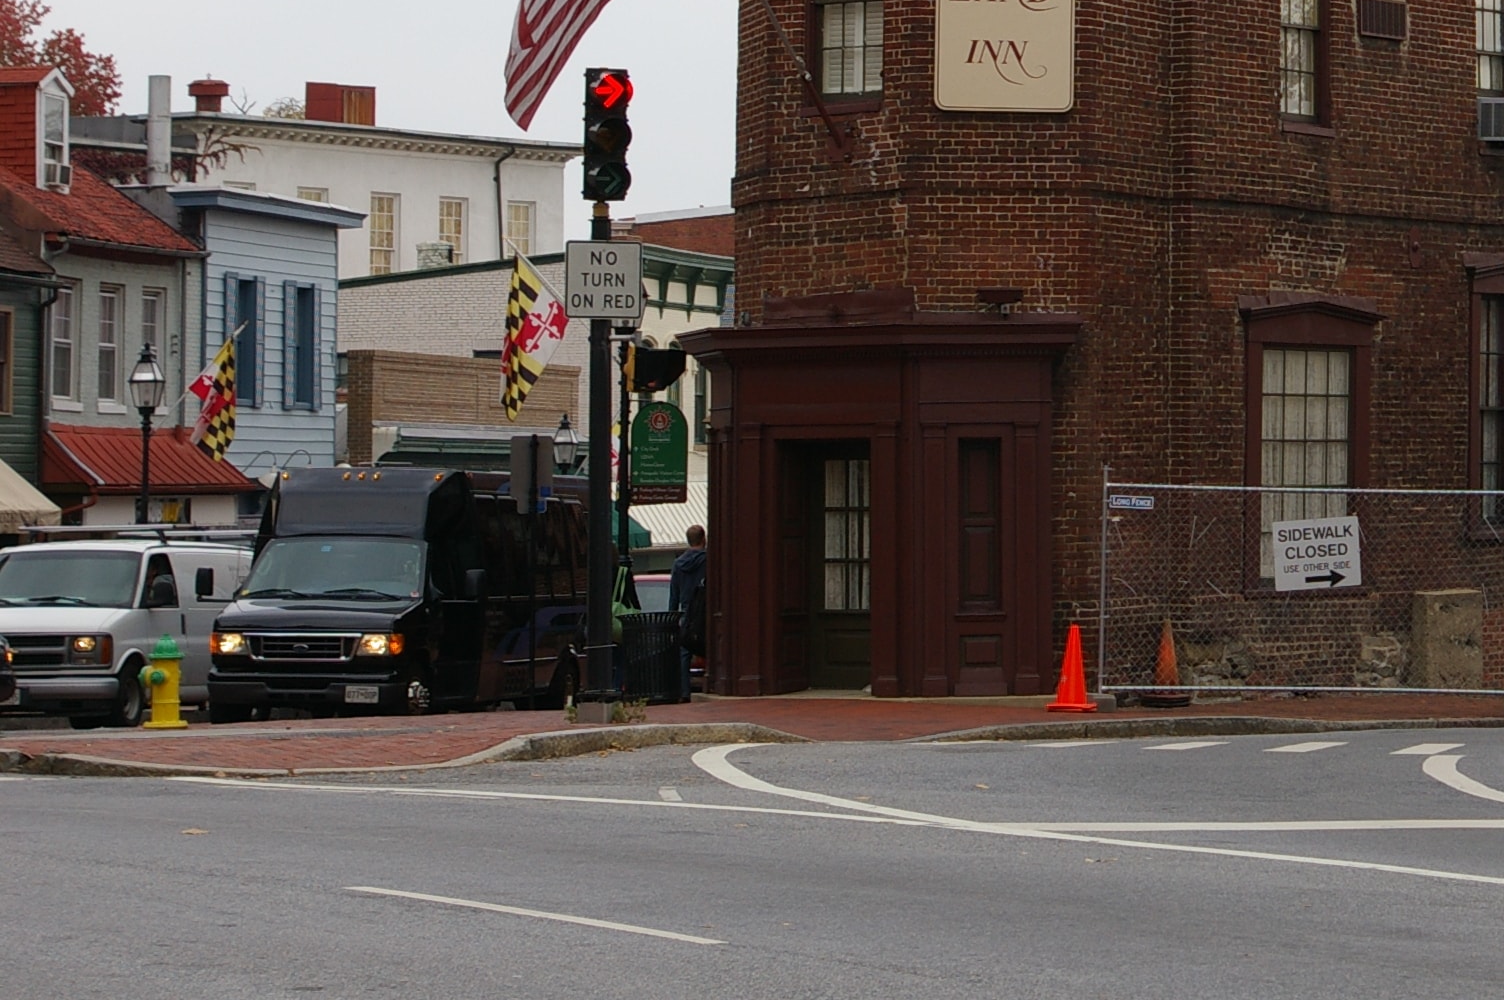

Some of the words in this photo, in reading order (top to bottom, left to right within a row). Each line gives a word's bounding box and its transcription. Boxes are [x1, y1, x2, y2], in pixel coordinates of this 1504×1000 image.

[964, 39, 1048, 85] INN
[590, 250, 618, 266] NO
[580, 272, 625, 288] TURN
[571, 293, 594, 309] ON
[603, 294, 635, 310] RED
[1278, 525, 1353, 543] SIDEWALK
[1285, 543, 1349, 560] CLOSED
[1283, 564, 1300, 573] USE
[1303, 562, 1329, 572] OTHER
[1333, 560, 1352, 570] SIDE
